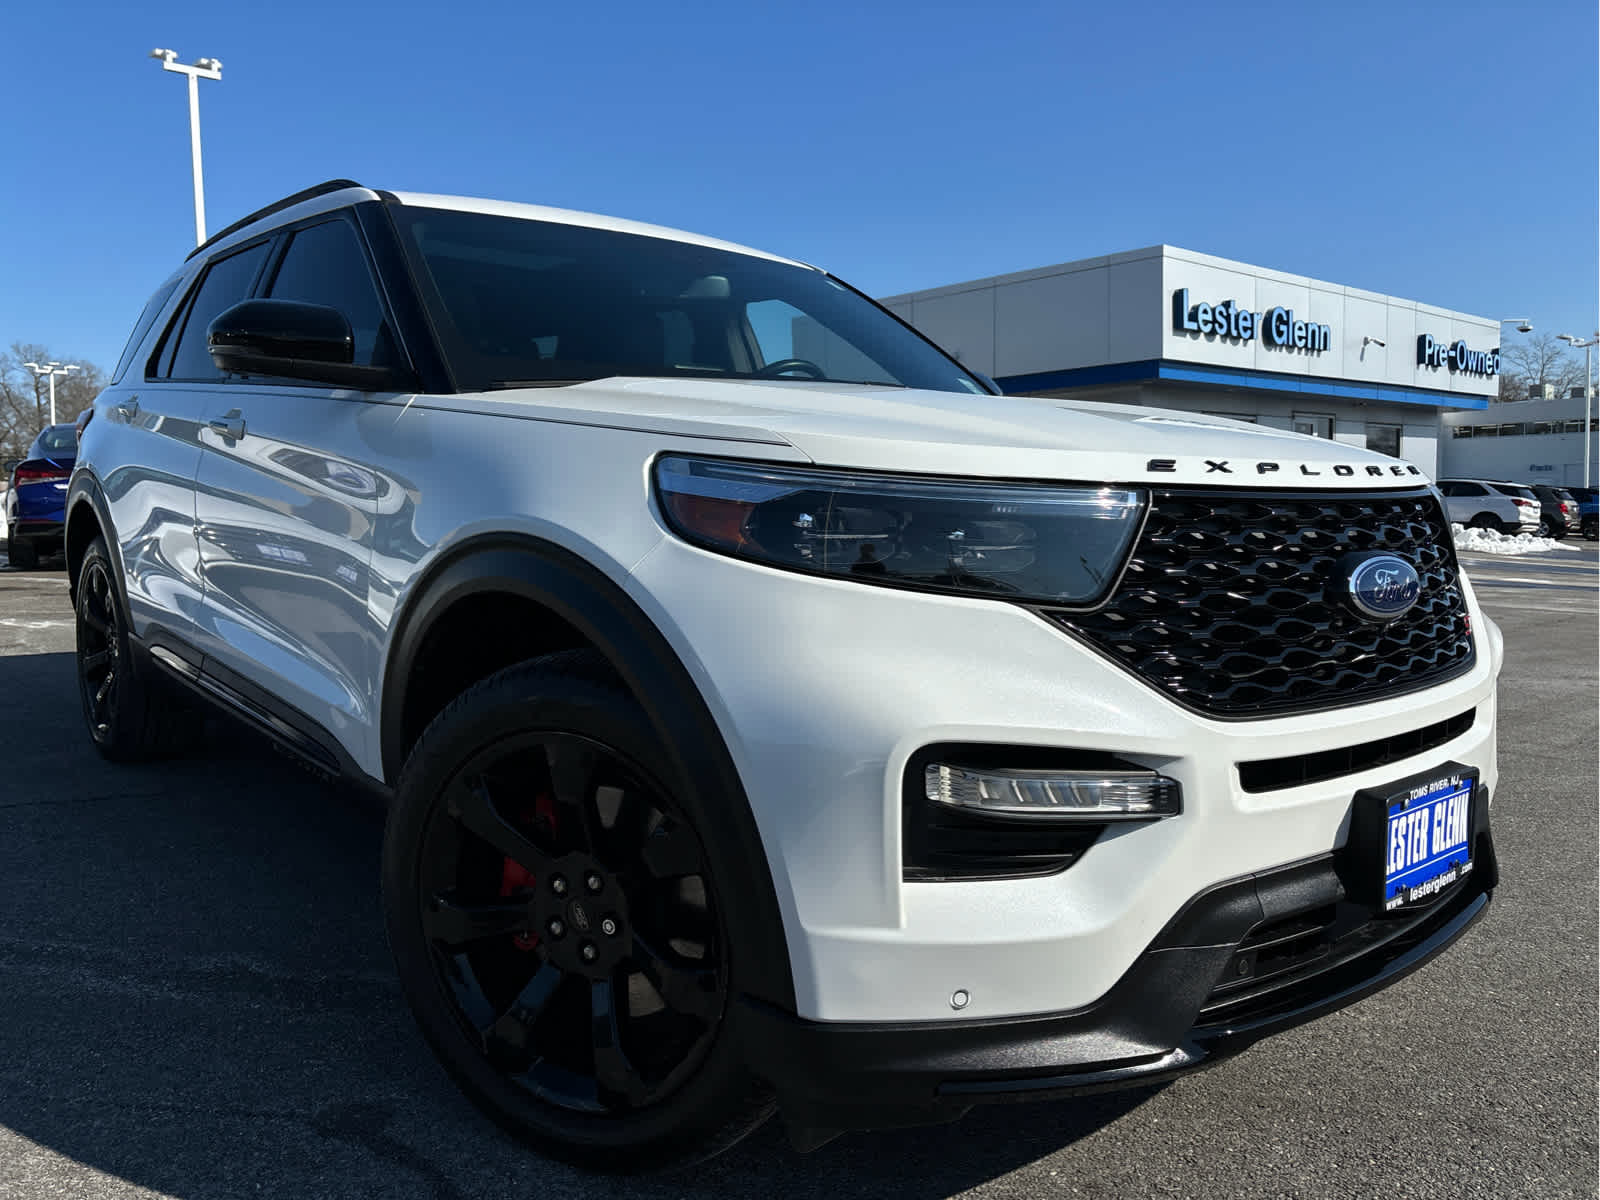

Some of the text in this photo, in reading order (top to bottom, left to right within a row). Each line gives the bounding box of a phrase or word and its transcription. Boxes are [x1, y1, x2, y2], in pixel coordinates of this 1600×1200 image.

[1173, 288, 1331, 352] Lester Glenn
[1147, 459, 1421, 476] EXPLORER
[1374, 569, 1412, 602] Ford
[1410, 785, 1428, 800] TOMS
[1450, 775, 1460, 786] NJ
[1432, 792, 1470, 855] GLENN
[1410, 870, 1456, 901] lesterglenn
